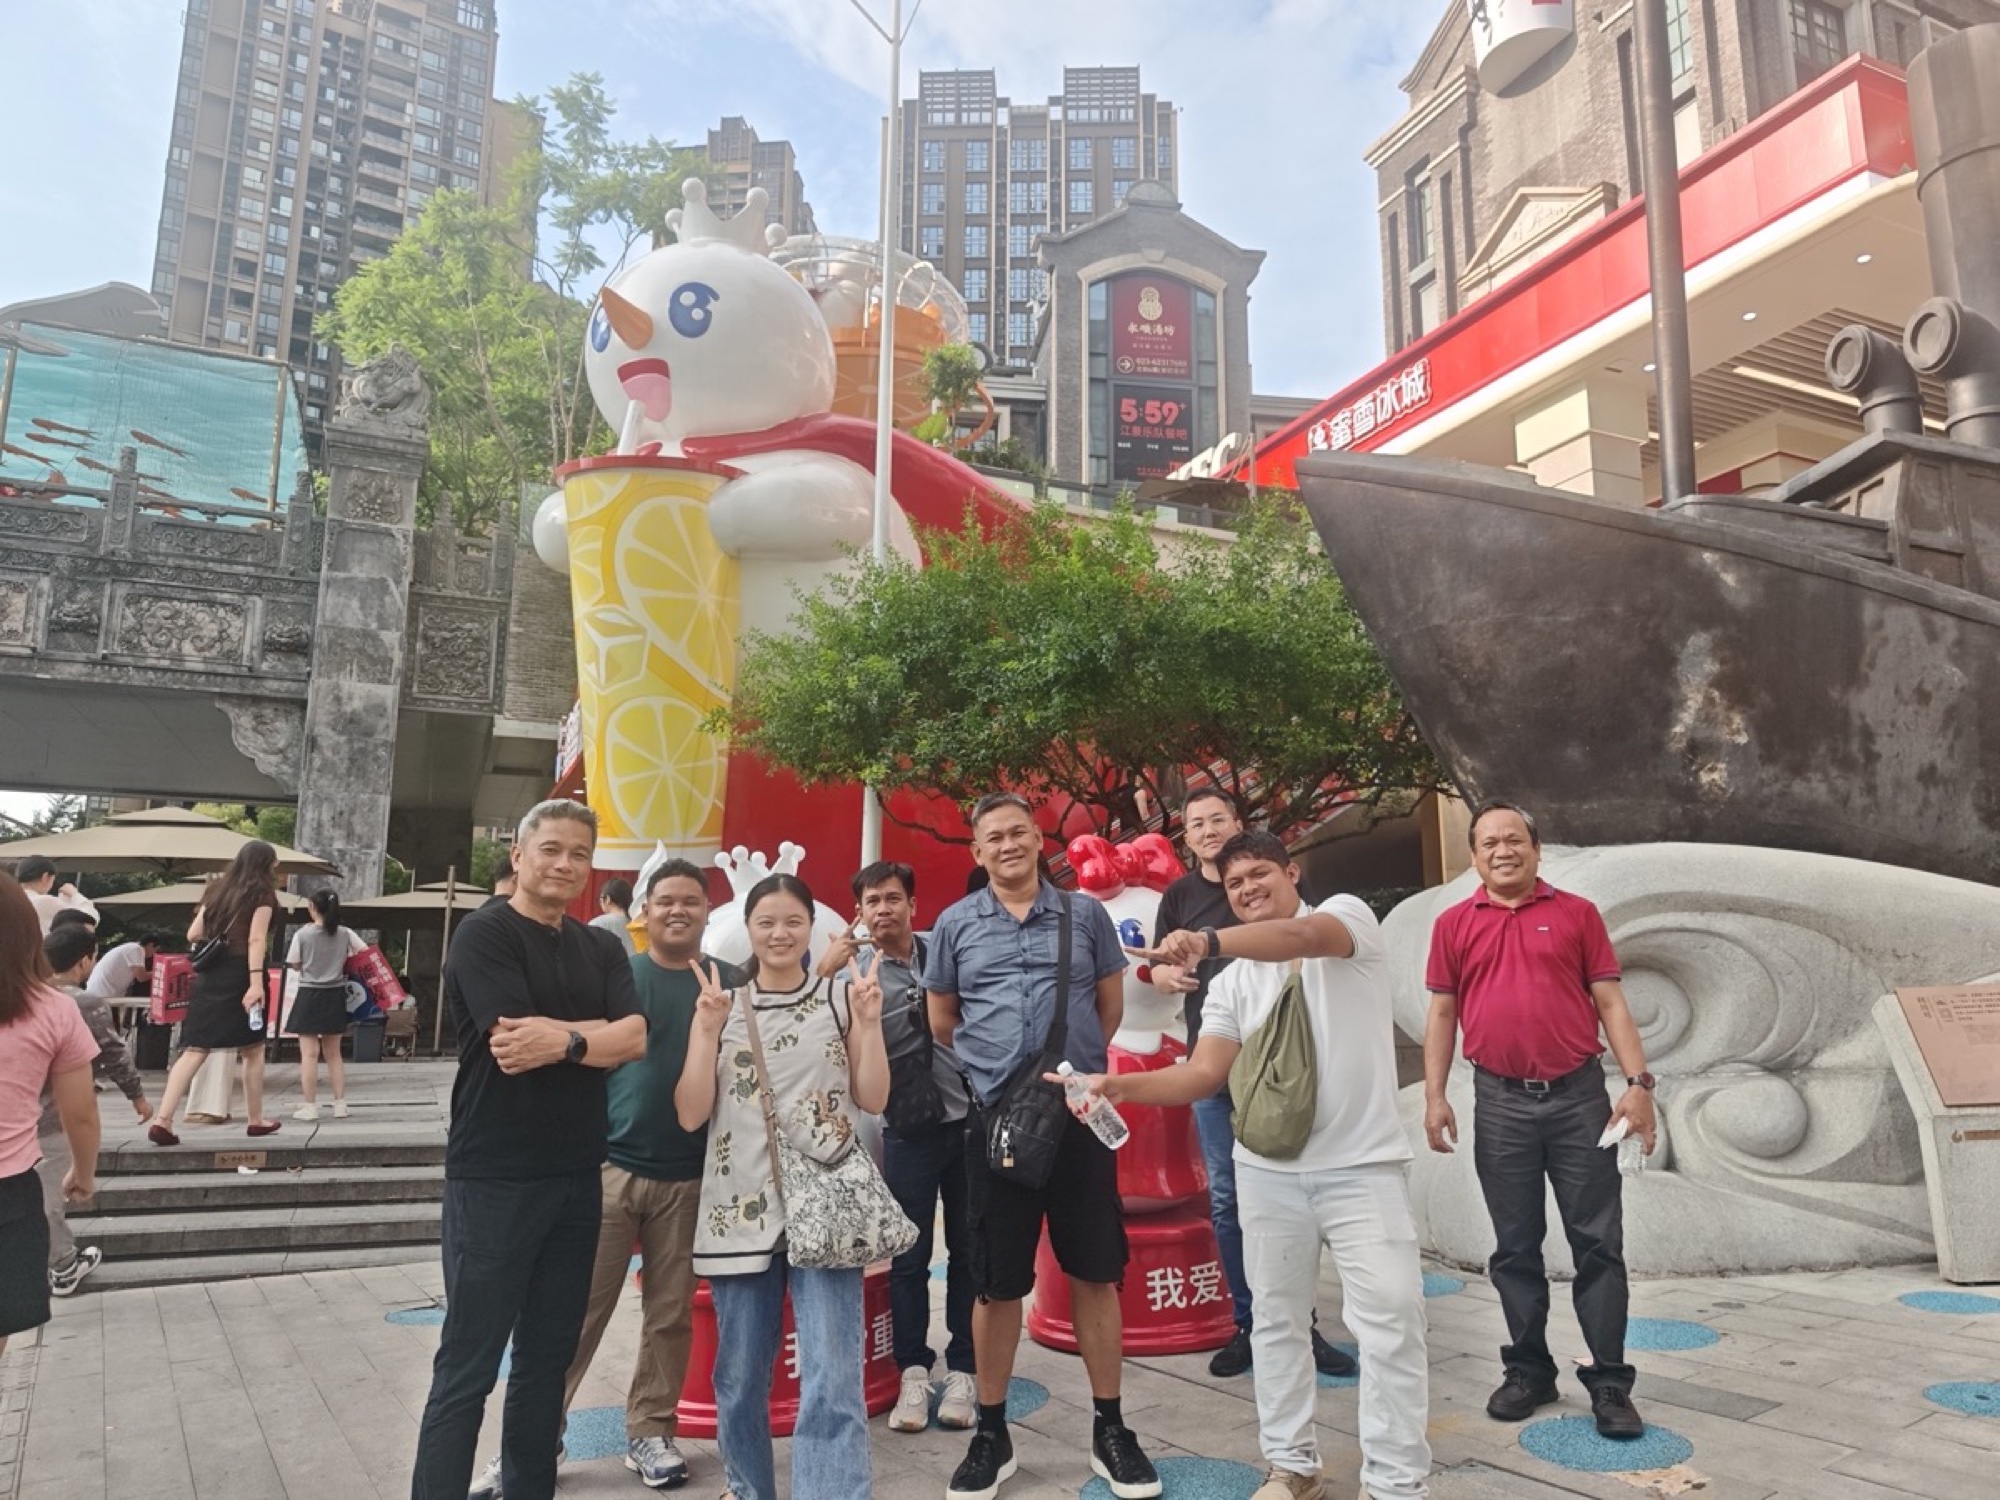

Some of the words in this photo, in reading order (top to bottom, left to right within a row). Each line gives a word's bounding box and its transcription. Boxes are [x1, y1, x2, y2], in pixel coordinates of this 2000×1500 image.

[1330, 360, 1426, 451] 蜜雪冰城
[1146, 1261, 1233, 1312] 我爱
